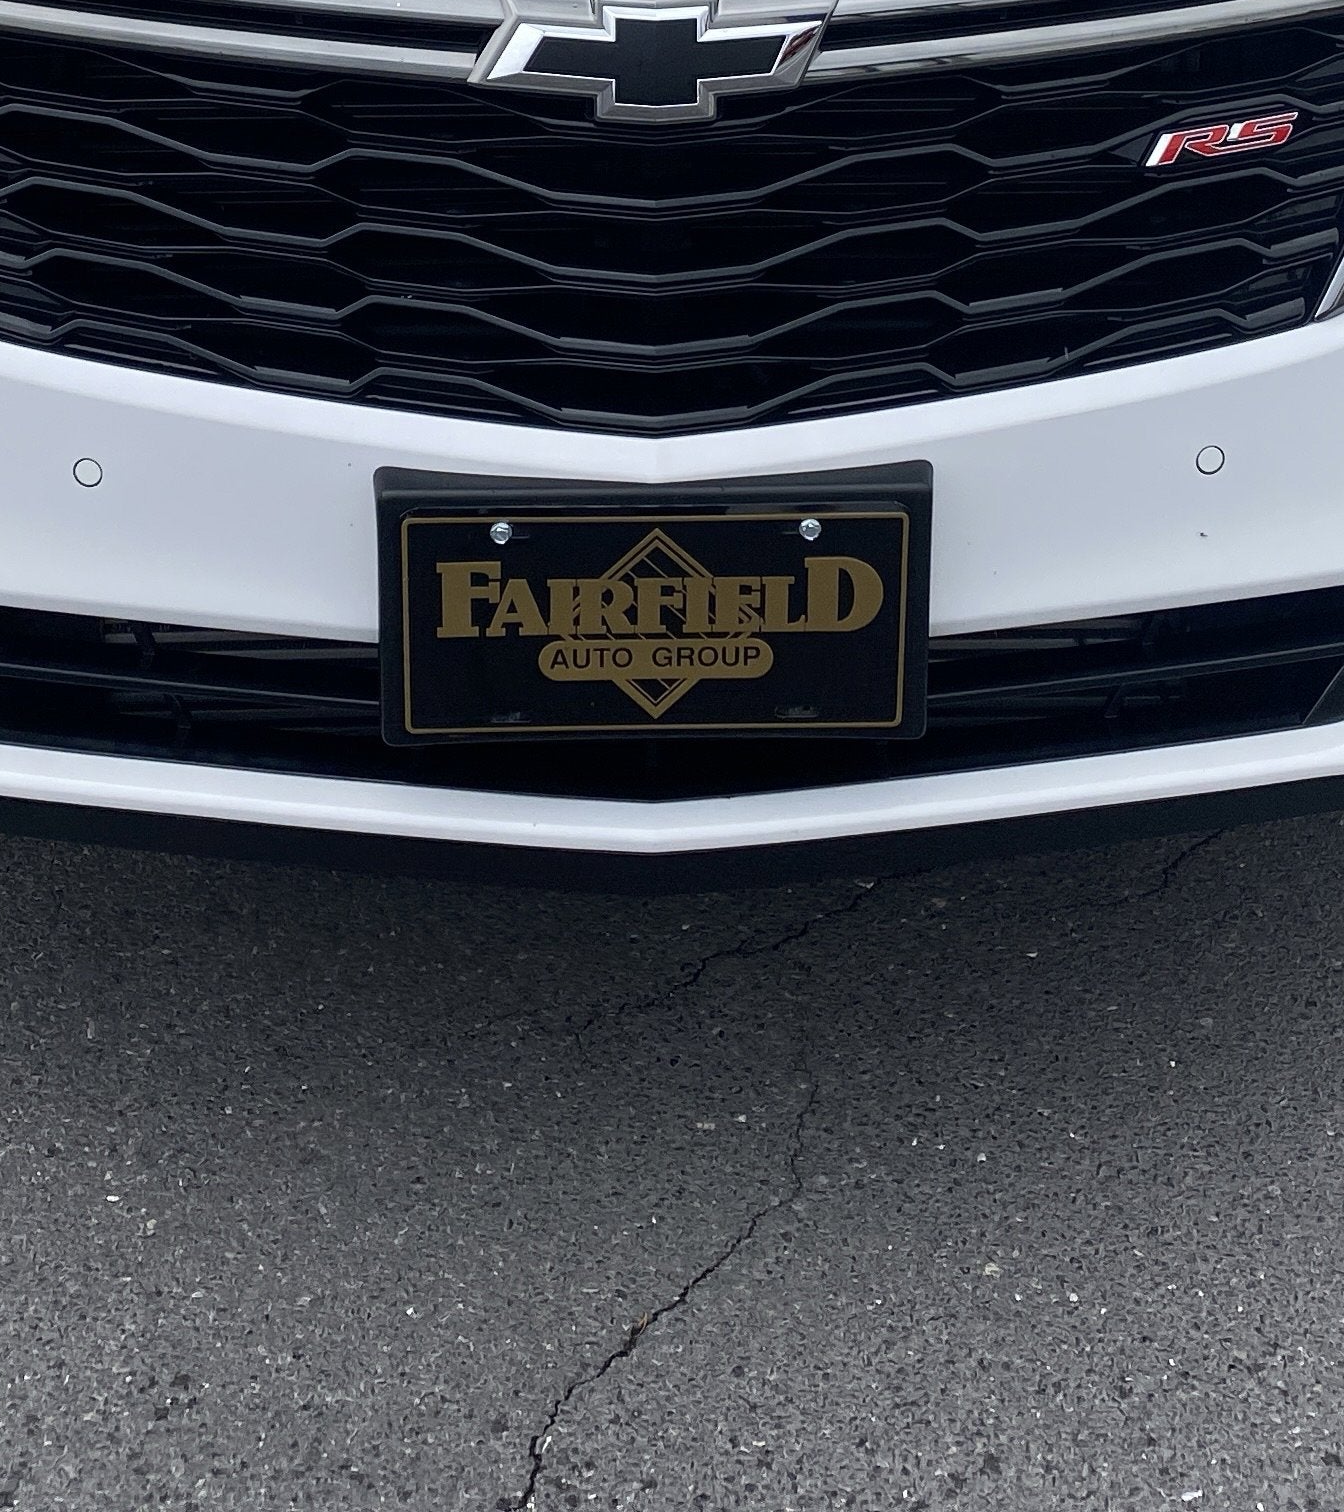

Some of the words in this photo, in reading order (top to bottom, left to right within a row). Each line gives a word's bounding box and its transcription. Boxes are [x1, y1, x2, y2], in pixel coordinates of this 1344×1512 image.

[1145, 111, 1299, 167] RS
[436, 556, 884, 639] FAIRFIELD
[549, 646, 634, 671] AUTO
[651, 645, 762, 669] GROUP
